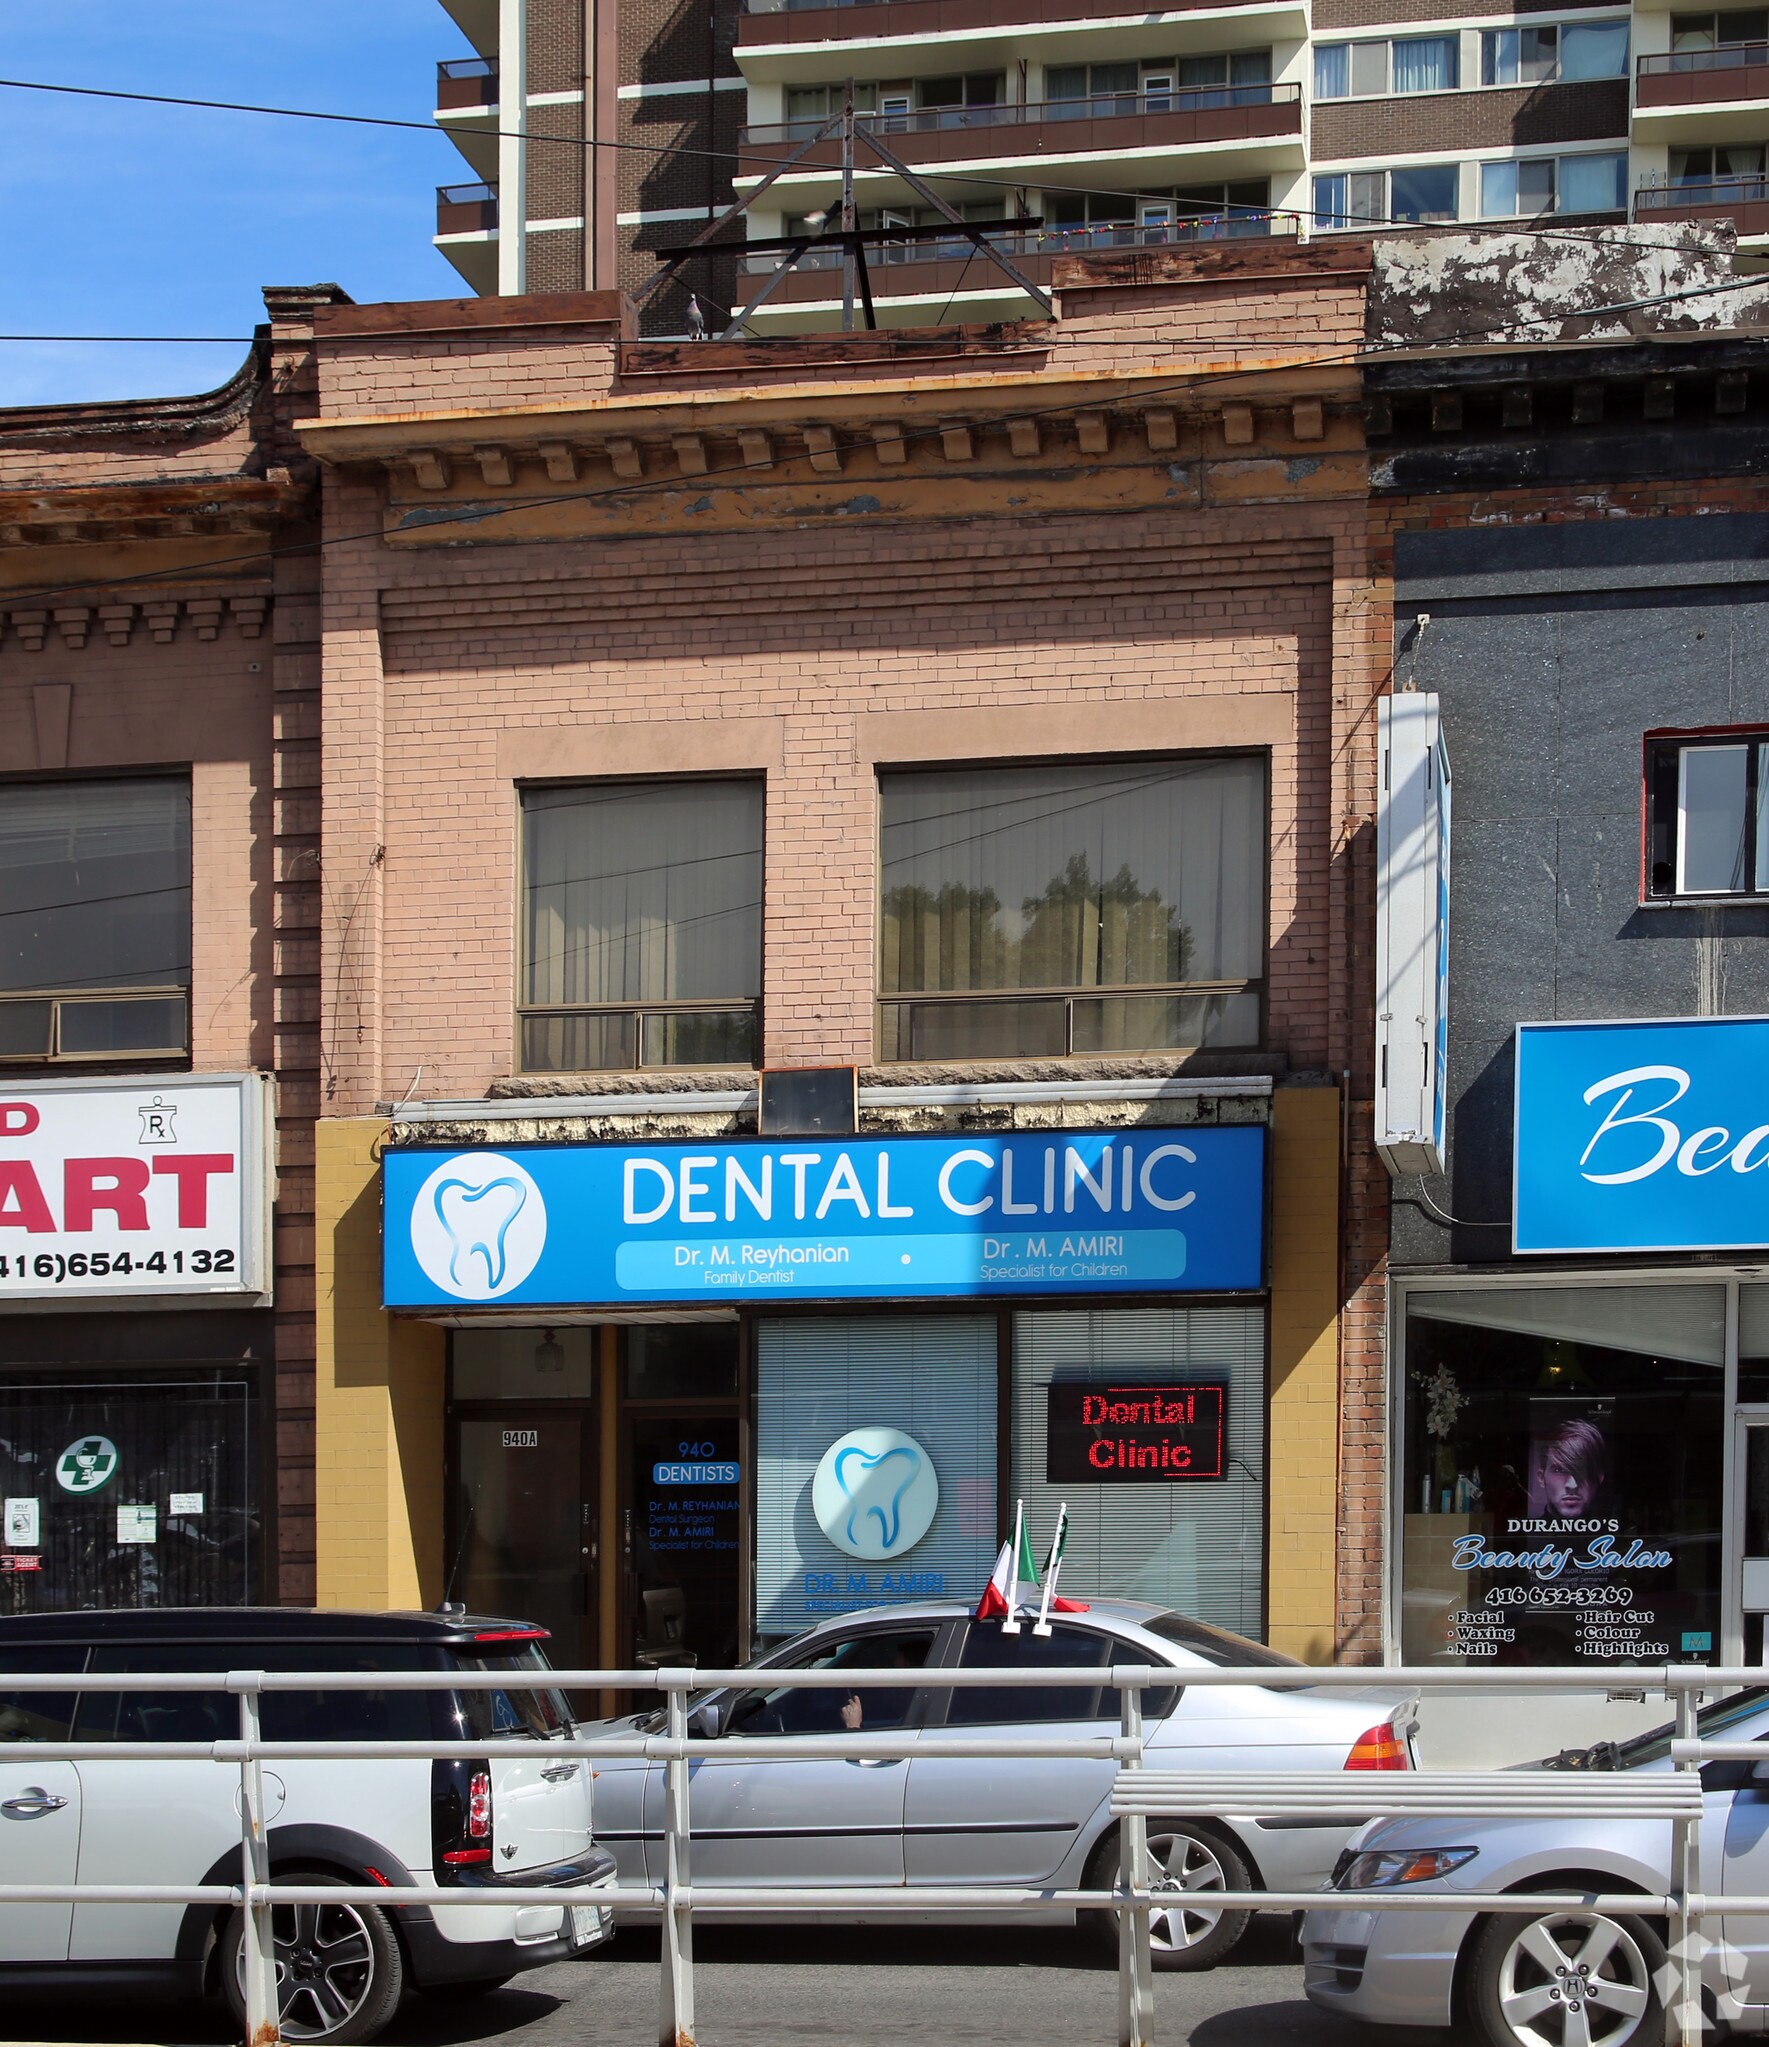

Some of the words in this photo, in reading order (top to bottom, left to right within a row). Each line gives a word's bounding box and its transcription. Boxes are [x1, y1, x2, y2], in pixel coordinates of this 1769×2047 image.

[623, 1151, 914, 1225] DENTAL
[938, 1144, 1197, 1216] CLINIC
[674, 1246, 704, 1266] Dr.
[710, 1246, 736, 1265] M.
[741, 1243, 849, 1268] Reyhanian
[1026, 1238, 1052, 1258] M.
[1059, 1236, 1123, 1257] AMIRI
[704, 1270, 746, 1287] Family
[749, 1269, 795, 1284] Dentist
[980, 1263, 1045, 1281] Specialist
[1049, 1263, 1066, 1277] for
[1072, 1262, 1127, 1277] Children
[1082, 1394, 1195, 1425] Dental
[503, 1431, 536, 1446] 940A
[678, 1441, 715, 1458] 940
[1088, 1439, 1192, 1468] Clinic
[658, 1465, 735, 1482] DENTISTS
[668, 1501, 681, 1511] M.
[682, 1501, 741, 1511] REYHANIAN
[649, 1514, 677, 1524] Dental
[679, 1514, 715, 1525] Surgeon
[1507, 1518, 1620, 1533] DURANGO'S
[668, 1527, 681, 1537] M.
[684, 1527, 714, 1537] AMIRI
[648, 1540, 688, 1552] Specialist
[1451, 1534, 1573, 1580] Beauty
[1573, 1534, 1673, 1570] Salon
[880, 1573, 944, 1593] AMIRI
[1485, 1586, 1527, 1606] 416
[1528, 1586, 1633, 1606] 652-3269
[1456, 1610, 1504, 1624] Facial
[1583, 1610, 1622, 1624] Hair
[1623, 1610, 1655, 1624] Cut
[1457, 1626, 1516, 1642] Waxing
[1584, 1625, 1641, 1639] Colour
[1455, 1641, 1498, 1656] Nails
[1583, 1641, 1670, 1658] Highlights
